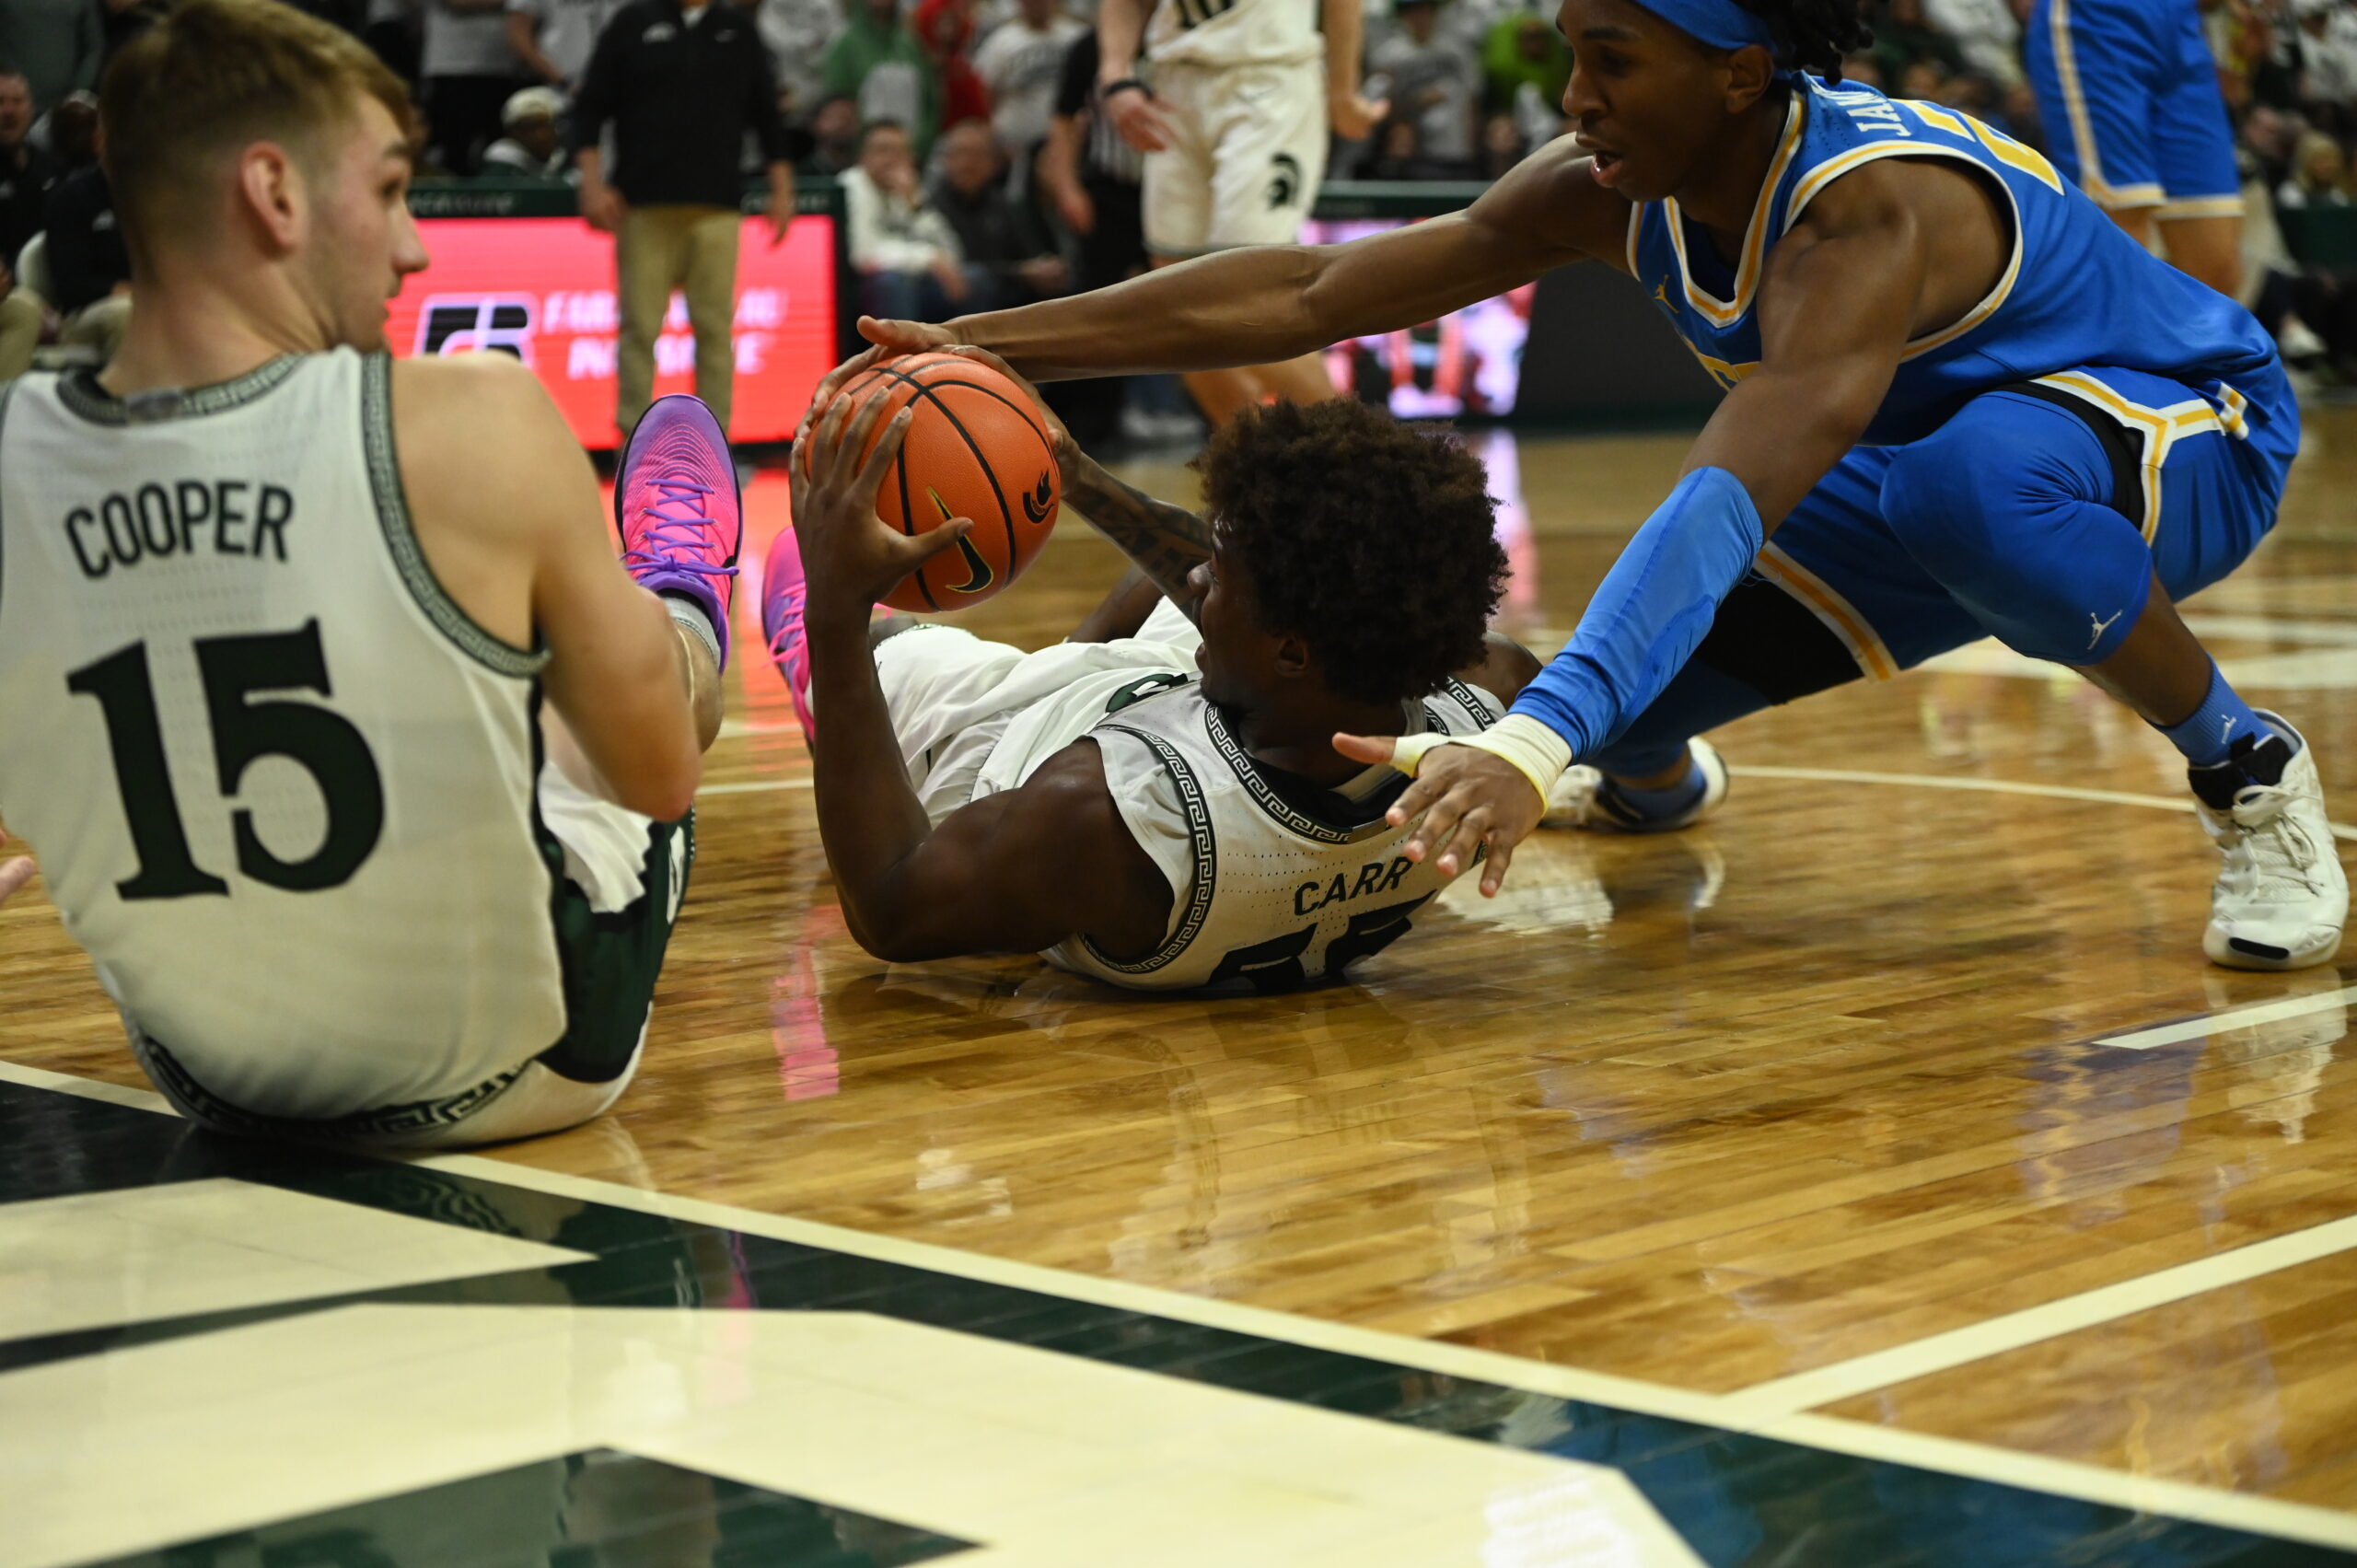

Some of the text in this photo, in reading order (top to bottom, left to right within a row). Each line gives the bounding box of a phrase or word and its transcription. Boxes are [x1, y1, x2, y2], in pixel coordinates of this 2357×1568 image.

[64, 478, 295, 580] COOPER
[65, 615, 386, 901] 15
[1294, 855, 1415, 916] CARR
